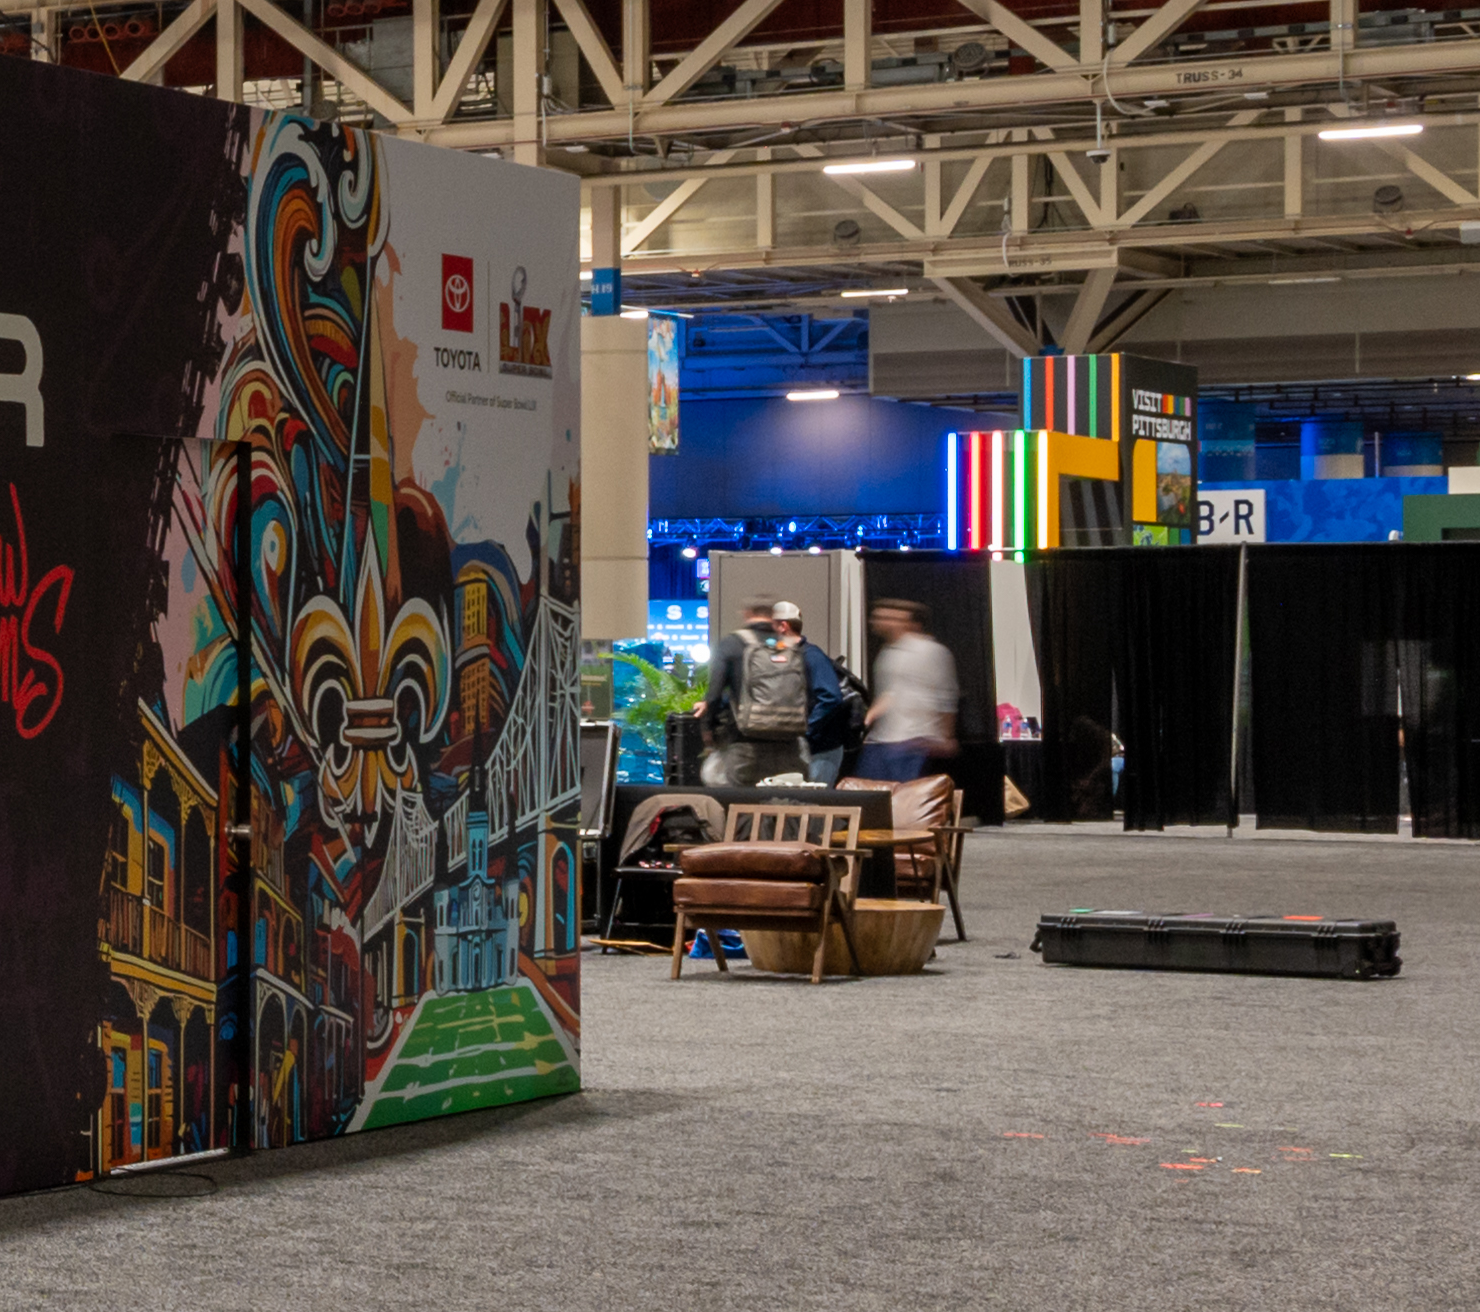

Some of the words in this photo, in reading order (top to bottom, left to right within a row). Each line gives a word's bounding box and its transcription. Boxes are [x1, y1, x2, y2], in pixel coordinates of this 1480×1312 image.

[434, 346, 482, 372] TOYOTA
[446, 390, 467, 404] Official
[467, 393, 489, 407] Partner
[496, 396, 513, 410] Super
[1131, 388, 1163, 412] VISIT
[1131, 414, 1192, 441] PITTSBURGH
